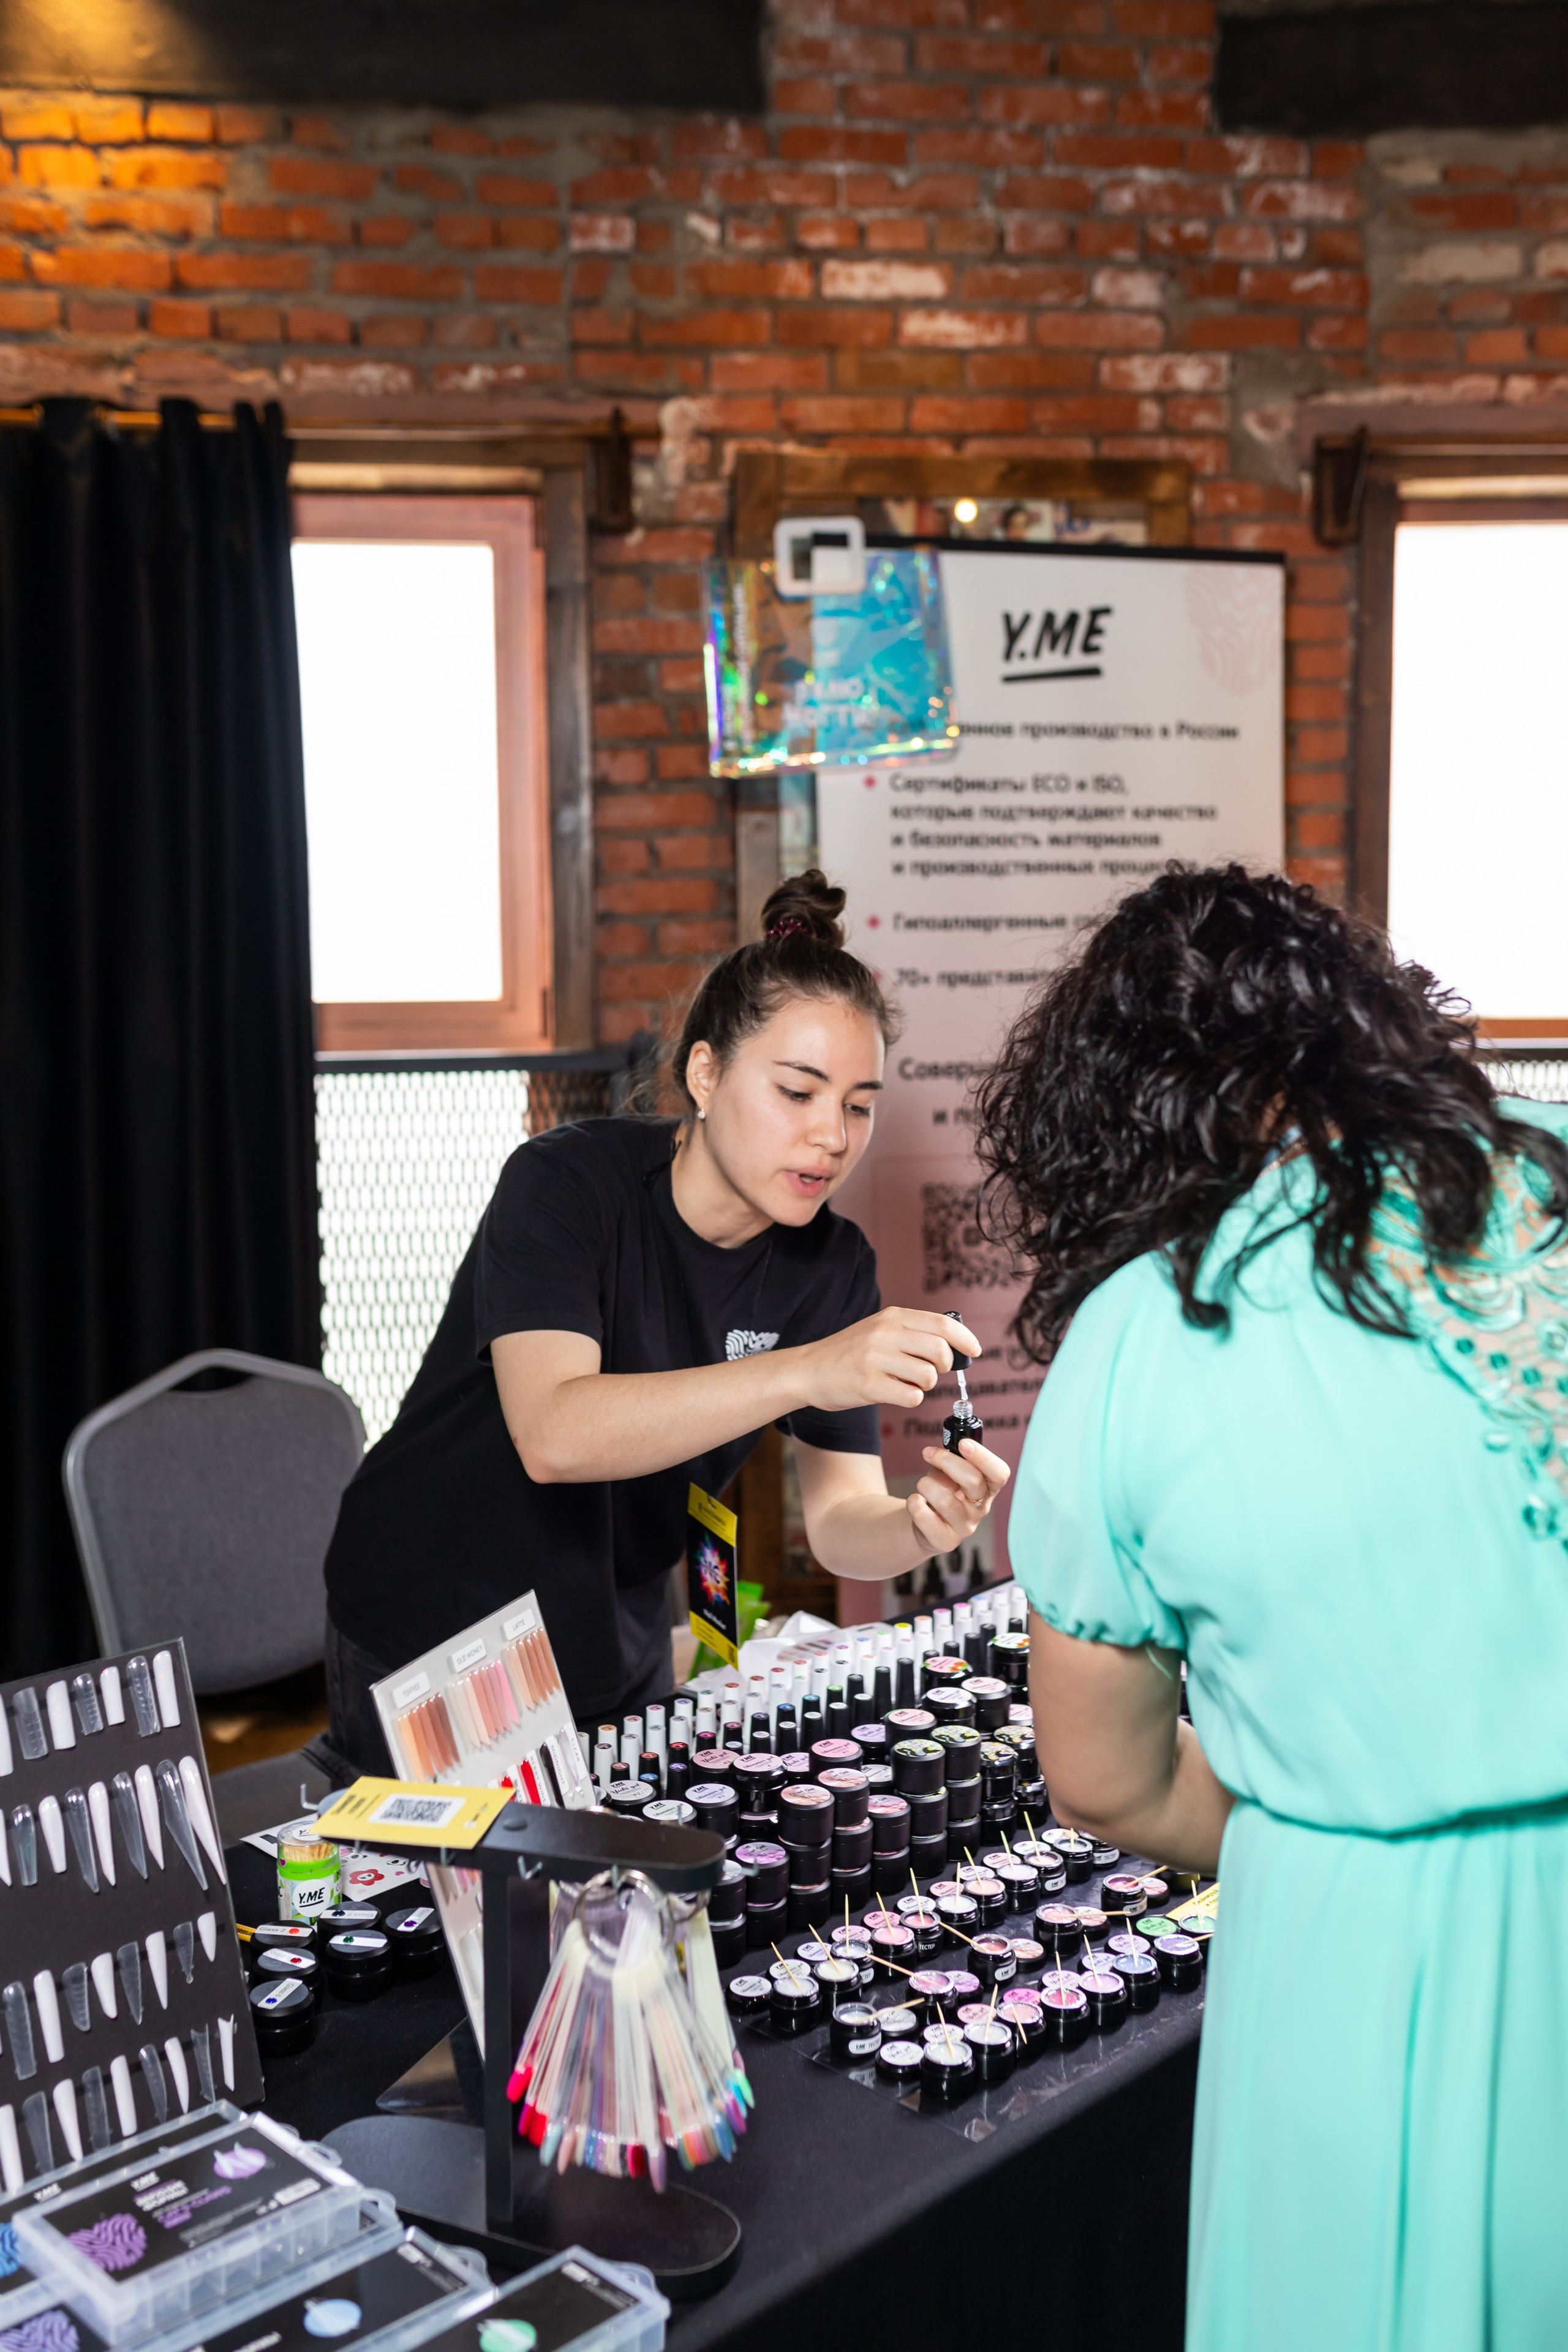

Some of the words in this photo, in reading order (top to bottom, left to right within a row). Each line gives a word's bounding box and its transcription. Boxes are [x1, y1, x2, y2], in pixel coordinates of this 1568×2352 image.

[1003, 606, 1113, 662] Y.ME
[1021, 723, 1152, 740] производство
[1161, 726, 1169, 736] в
[1177, 722, 1238, 739] России
[890, 774, 1024, 794] Сертификаты
[1077, 780, 1086, 791] и
[891, 806, 973, 820] которые
[982, 806, 1125, 821] подтверждают
[1133, 806, 1216, 820] качество
[892, 834, 903, 846] и
[909, 832, 1039, 846] безопасность
[1048, 834, 1159, 848] материалов
[893, 863, 903, 874] и
[911, 862, 1093, 878] производственных
[894, 913, 1066, 937] Гипоаллергенные
[513, 1619, 526, 1631] LATTE
[457, 1656, 467, 1665] OLD
[467, 1646, 483, 1660] MONEY
[571, 1738, 580, 1762] CLEAR
[530, 1756, 540, 1780] BERRY
[551, 1745, 565, 1784] MIDNIGHT
[298, 1887, 325, 1904] Y.ME
